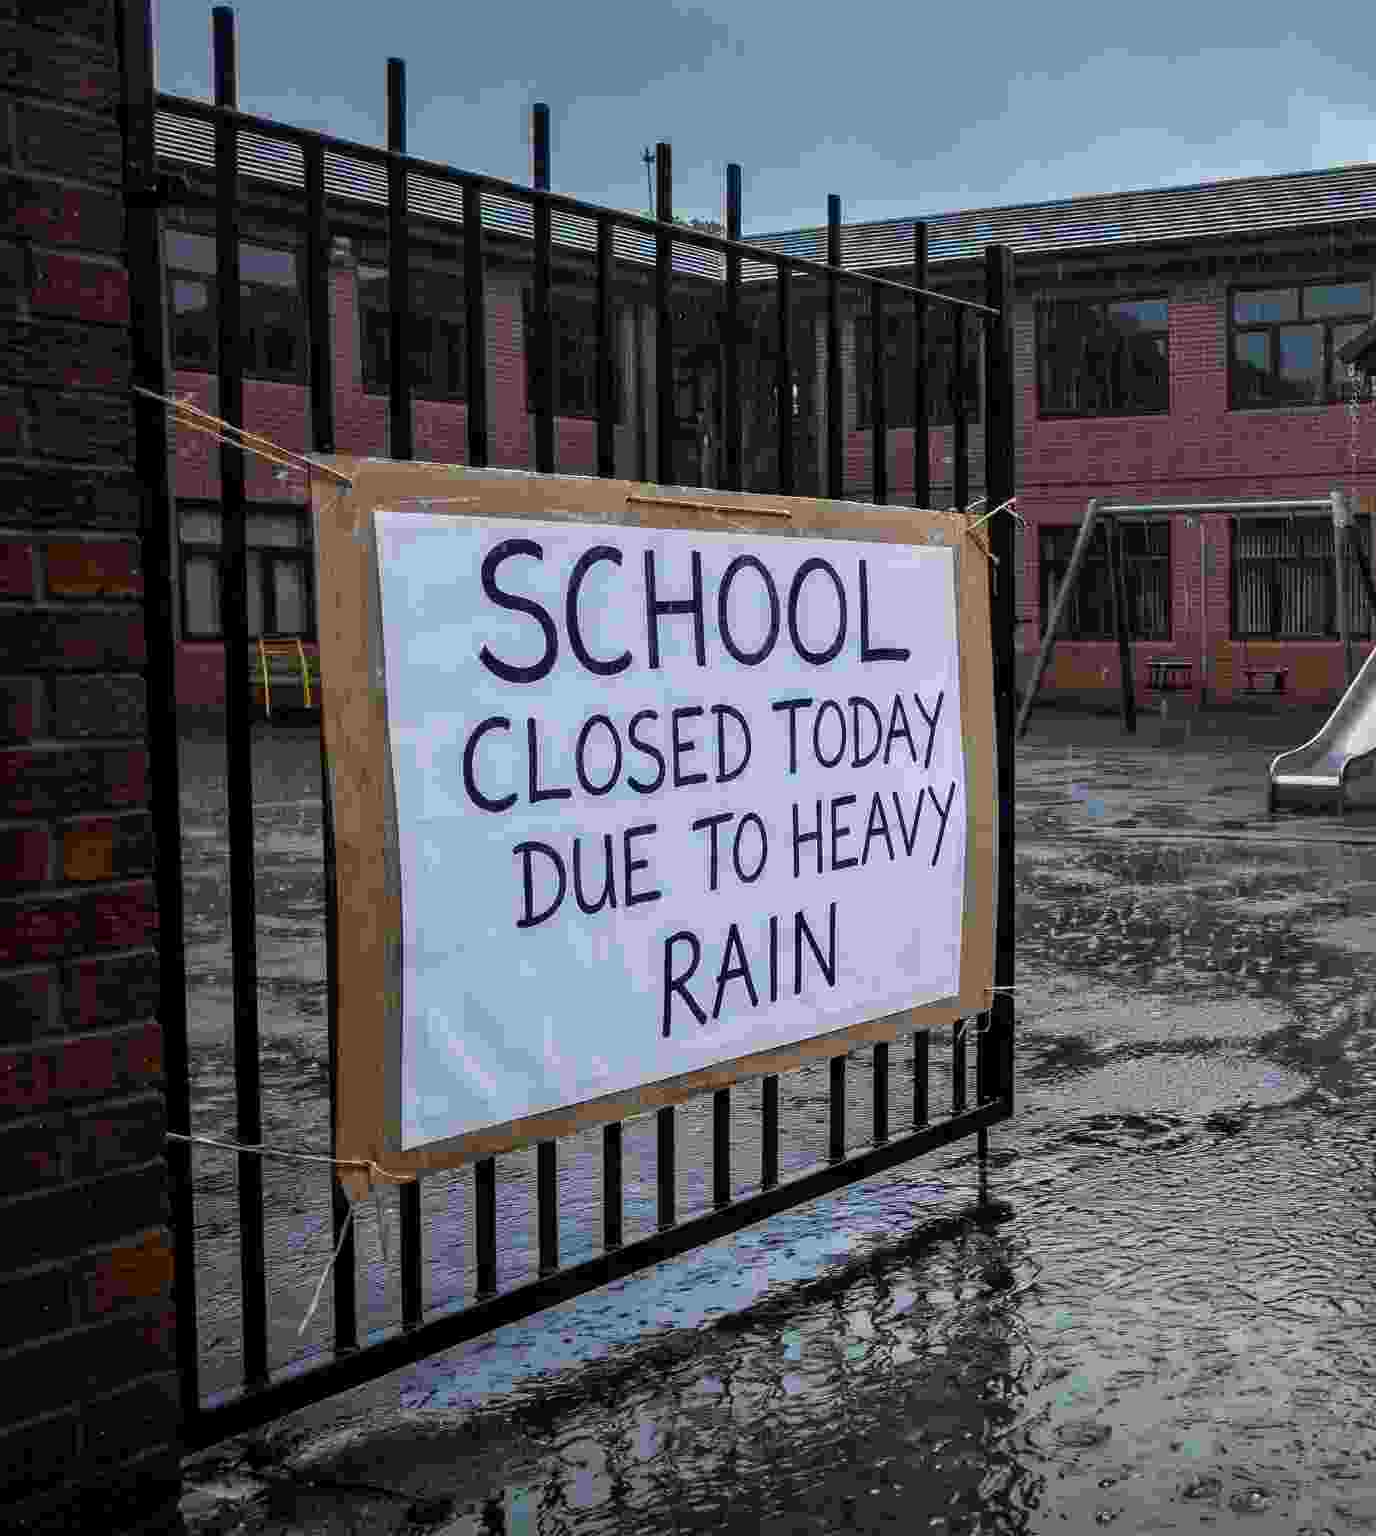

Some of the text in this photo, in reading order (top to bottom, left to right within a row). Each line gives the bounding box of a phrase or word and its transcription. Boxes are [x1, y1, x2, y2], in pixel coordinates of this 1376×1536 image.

[478, 538, 911, 684] SCHOOL
[462, 691, 945, 814] CLOSED TODAY
[511, 780, 957, 929] DUE TO HEAVY
[661, 901, 837, 1038] RAIN
